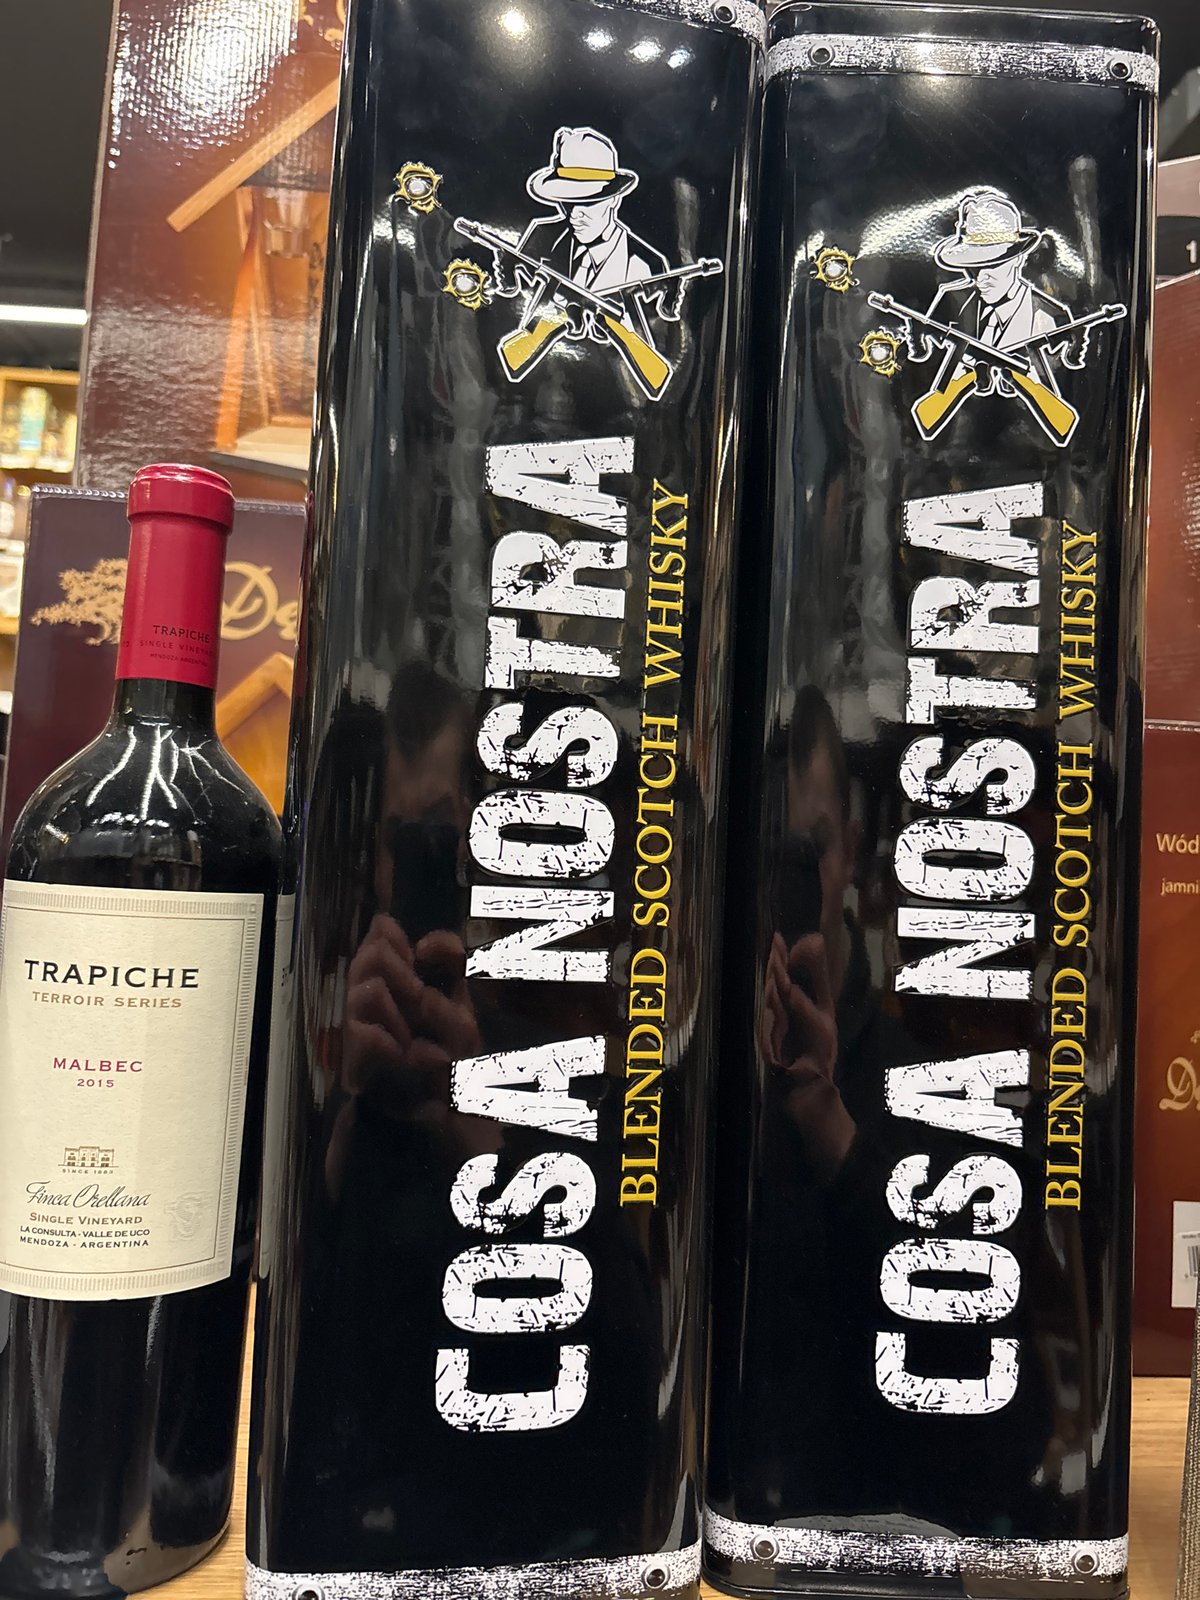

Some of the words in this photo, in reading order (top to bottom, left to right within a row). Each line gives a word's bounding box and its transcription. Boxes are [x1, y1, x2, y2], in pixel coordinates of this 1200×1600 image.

[153, 624, 210, 644] TRAPICHE
[644, 478, 689, 689] WHISKY
[1059, 520, 1098, 720] WHISKY
[465, 436, 634, 983] NOSTRA
[894, 481, 1044, 1000] NOSTRA
[633, 713, 678, 928] SCOTCH
[1053, 742, 1093, 948] SCOTCH
[1156, 833, 1199, 854] Wód
[24, 959, 199, 989] TRAPICHE
[32, 991, 105, 1007] TERROIR
[114, 997, 182, 1008] SERIES
[53, 1057, 143, 1073] MALBEC
[77, 1078, 114, 1088] 2015
[619, 948, 667, 1208] BLENDED
[1045, 967, 1088, 1211] BLENDED
[20, 1236, 69, 1248] MENDOZA
[80, 1240, 149, 1249] ARGENTINA
[26, 1180, 73, 1206] Finca
[72, 1183, 151, 1208] Orellana
[30, 1212, 74, 1225] SINGLE
[78, 1216, 143, 1225] VINEYARD
[129, 1229, 150, 1237] UCO
[434, 1034, 606, 1432] COSA
[875, 1048, 1030, 1415] COSA
